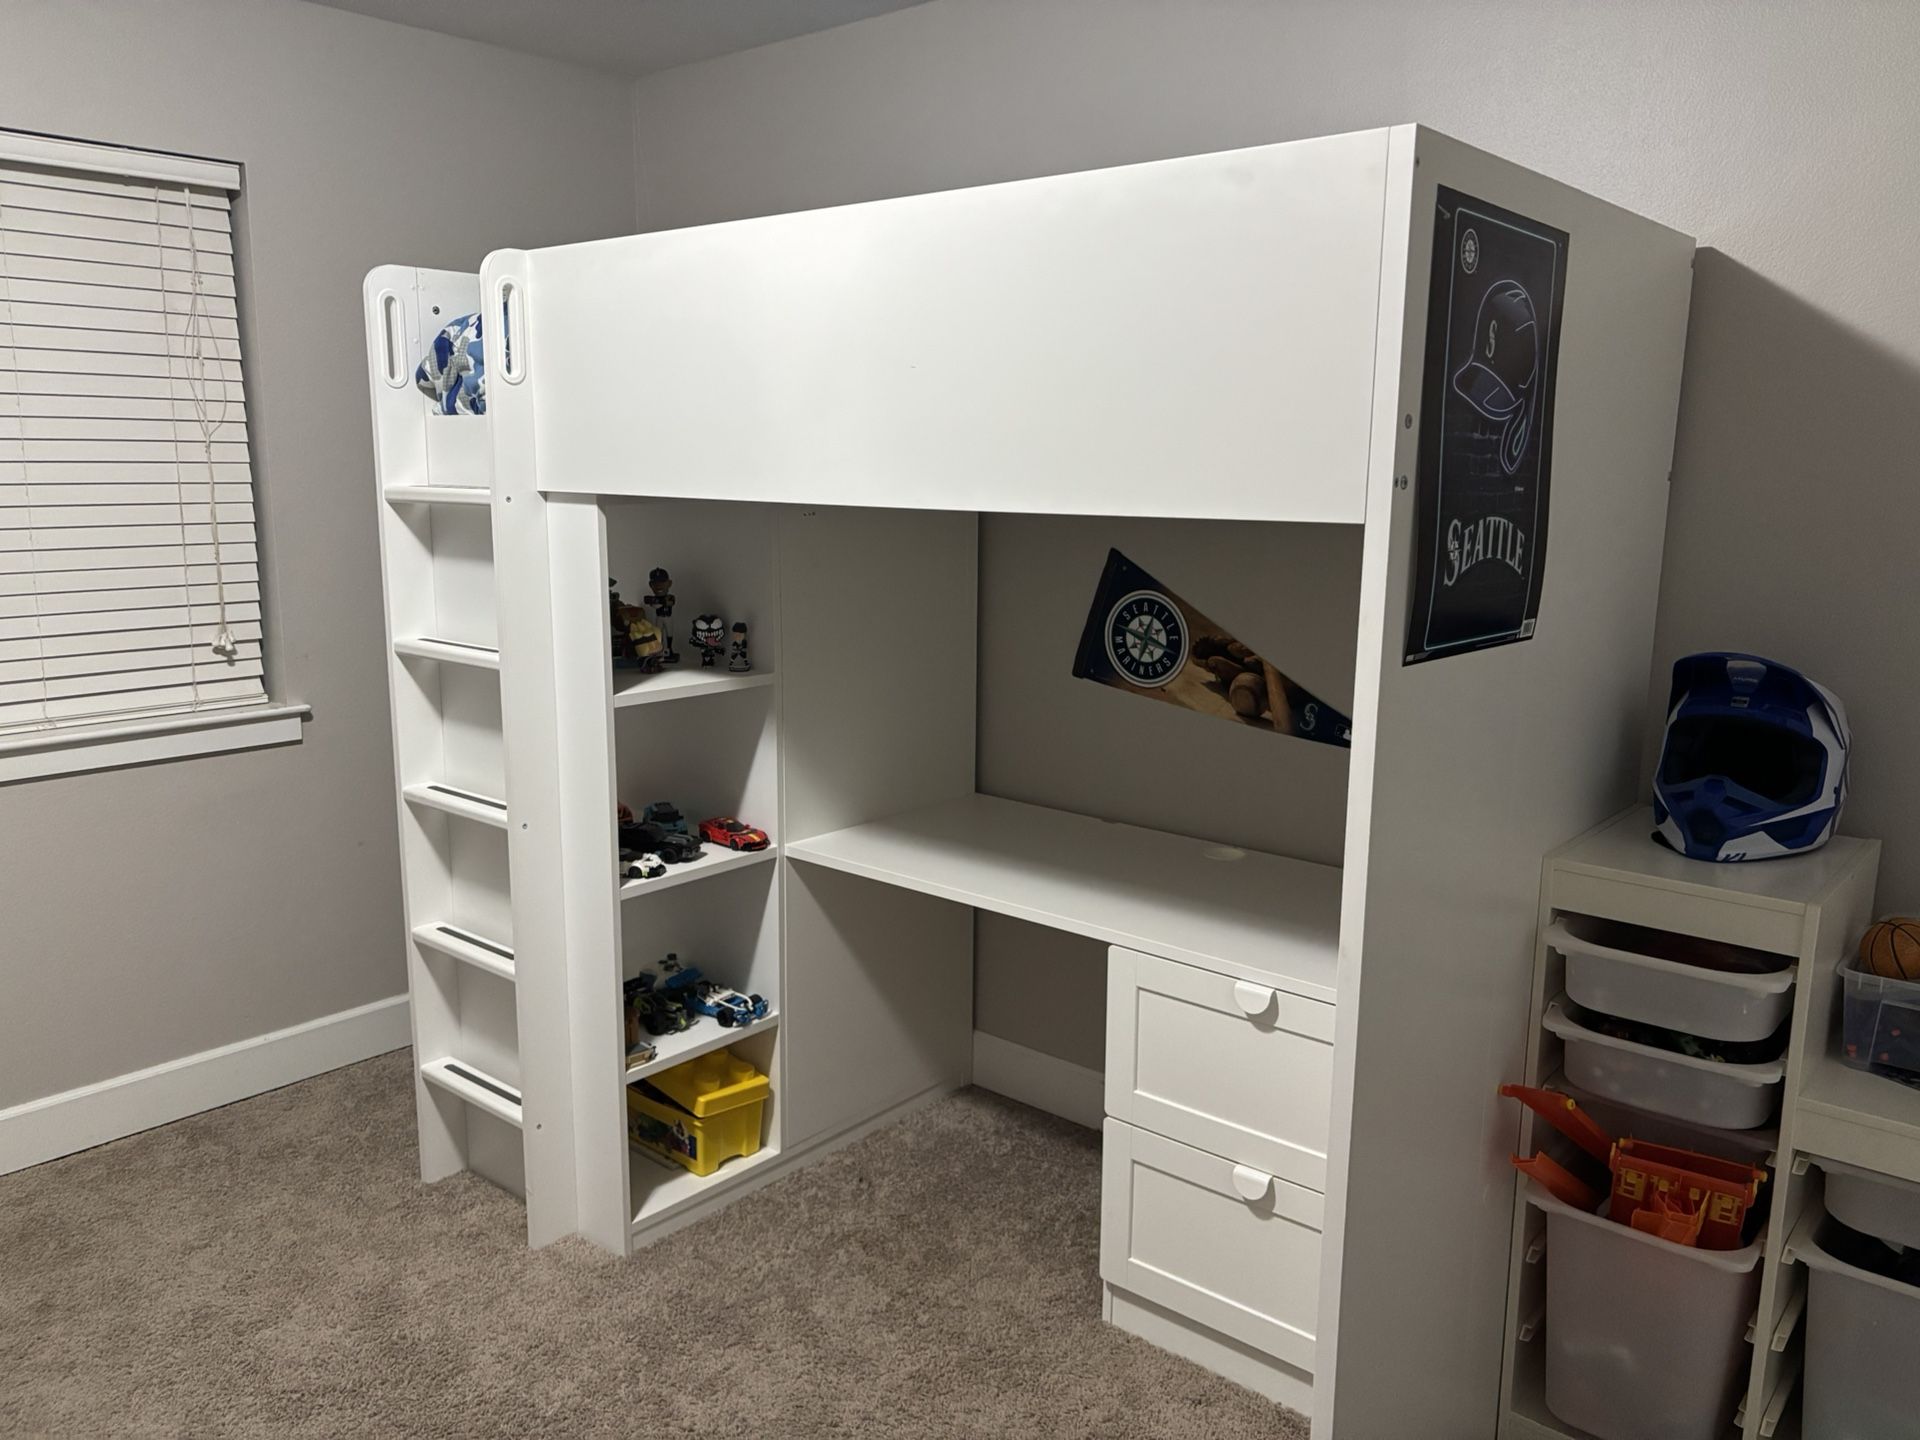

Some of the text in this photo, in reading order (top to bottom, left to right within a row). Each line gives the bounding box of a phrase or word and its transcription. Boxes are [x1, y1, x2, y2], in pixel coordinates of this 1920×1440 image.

[1443, 516, 1525, 586] SEATTLE
[1122, 601, 1179, 641] SEATTLE
[1114, 635, 1171, 676] MARINERS
